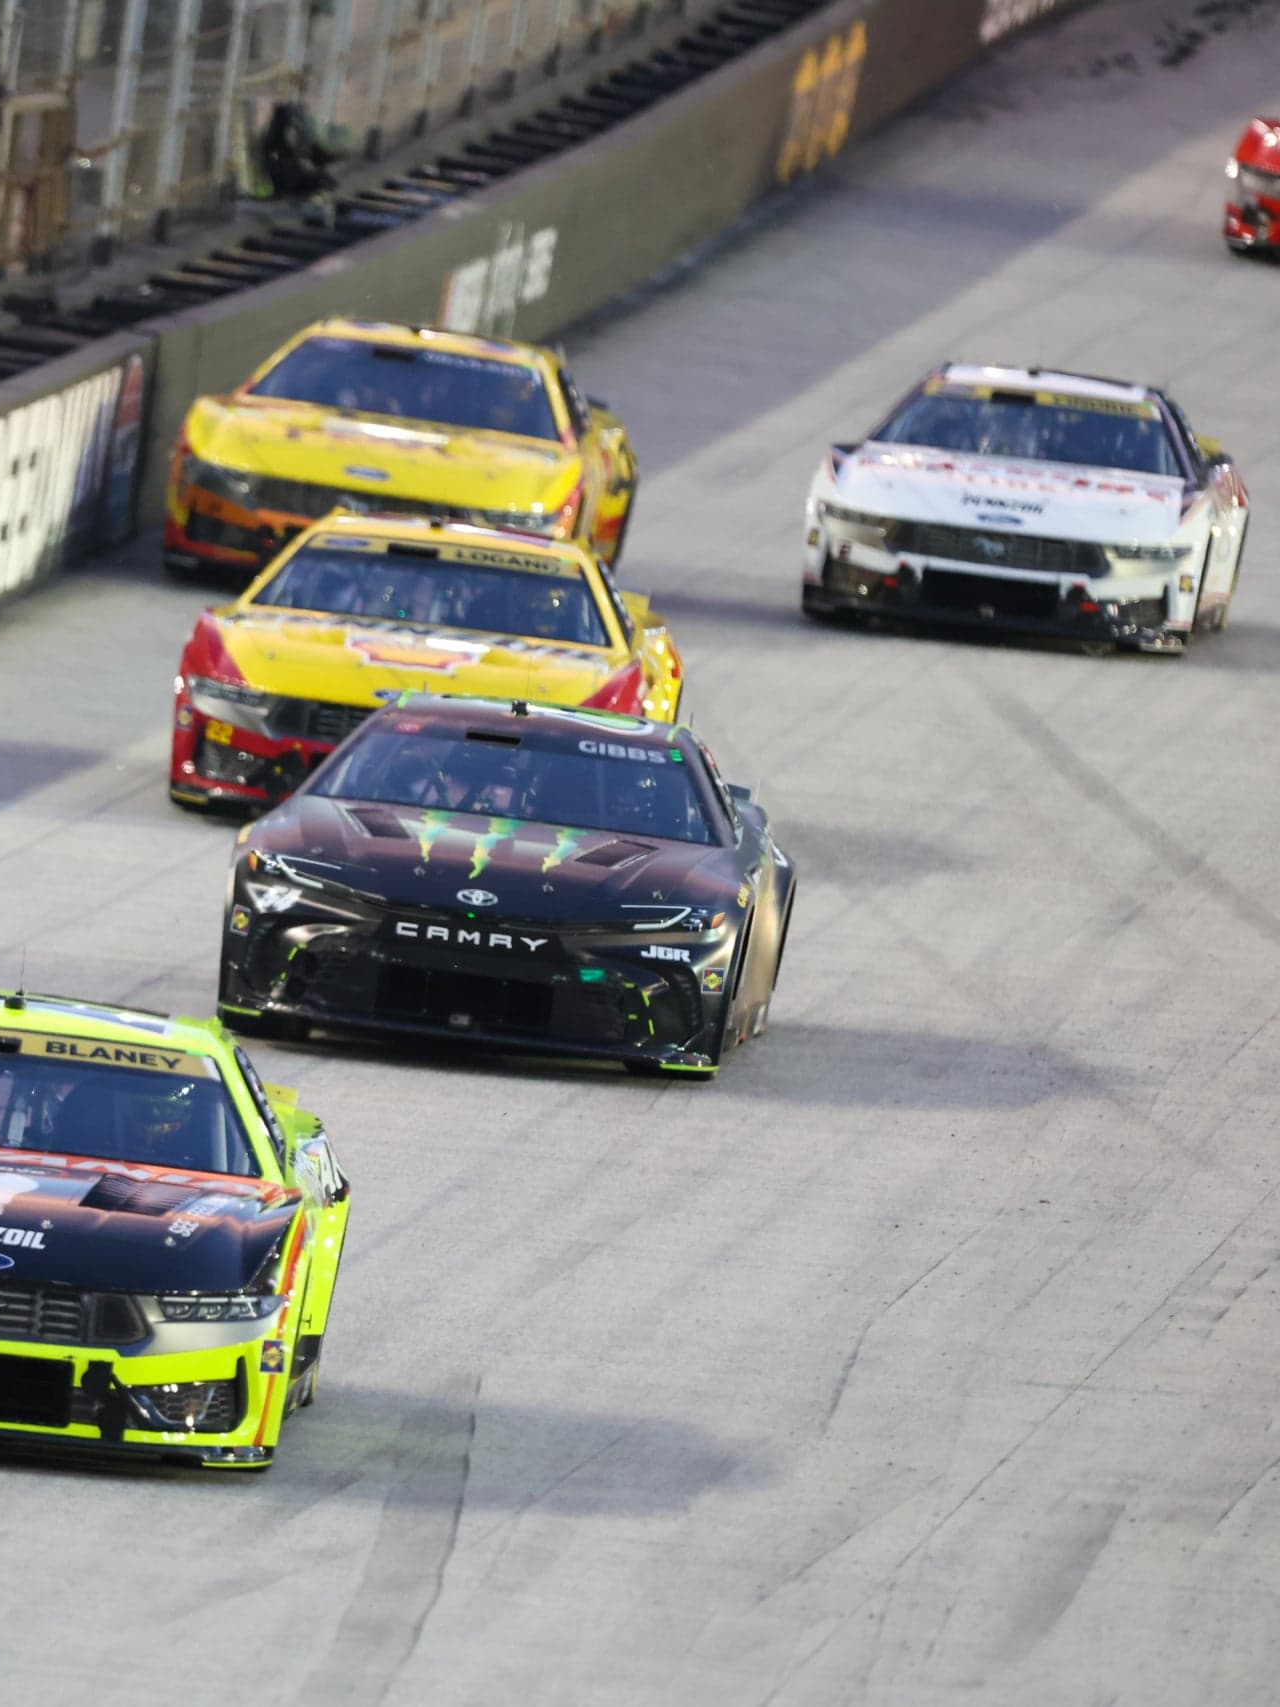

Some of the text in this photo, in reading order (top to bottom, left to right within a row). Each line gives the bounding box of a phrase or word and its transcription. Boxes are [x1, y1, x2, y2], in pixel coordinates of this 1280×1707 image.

[578, 740, 667, 764] GIBBS
[395, 921, 548, 952] CAMRY
[641, 944, 691, 963] JGR
[46, 1040, 183, 1070] BLANEY
